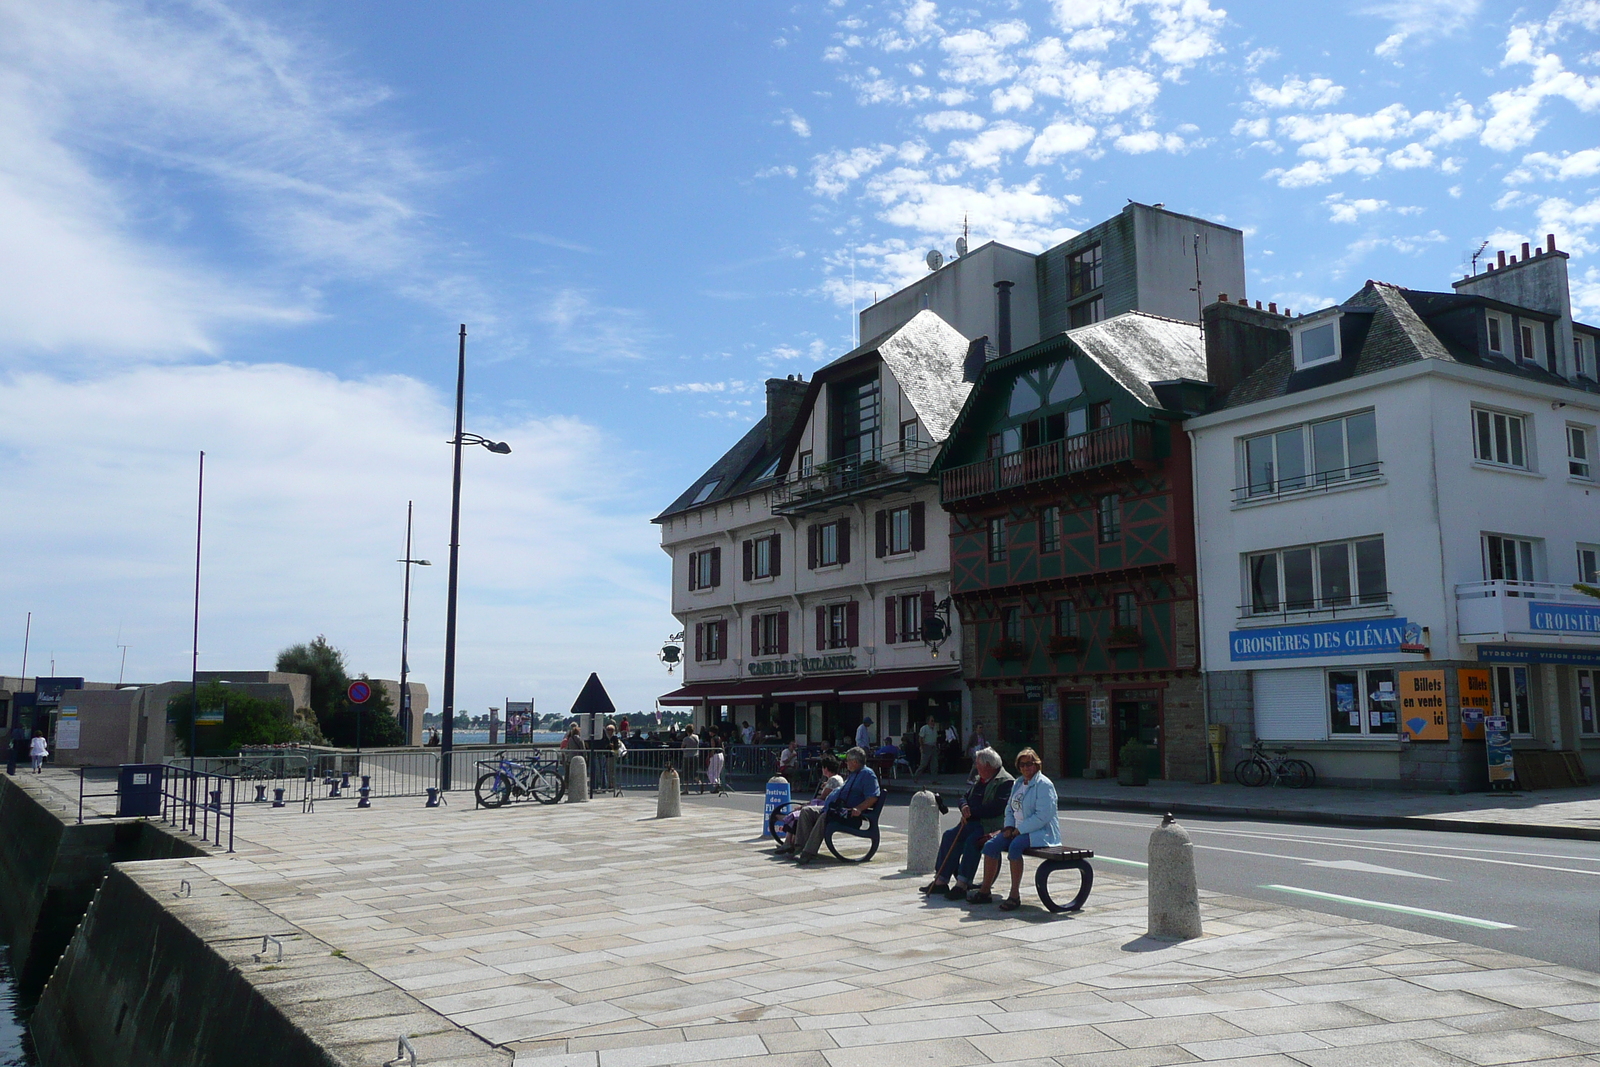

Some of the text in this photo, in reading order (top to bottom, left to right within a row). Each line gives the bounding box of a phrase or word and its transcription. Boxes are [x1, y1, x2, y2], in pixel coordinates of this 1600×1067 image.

[1234, 624, 1403, 653] CROISIÈRES DES GLÉNAN
[1482, 650, 1529, 658] HYDRO-JET
[1540, 652, 1568, 660] VISION
[774, 660, 789, 674] DE
[1413, 677, 1442, 692] Billets
[1468, 676, 1488, 691] Billets
[1403, 695, 1443, 708] en vente
[1462, 694, 1489, 706] en vente
[1433, 711, 1444, 725] ici
